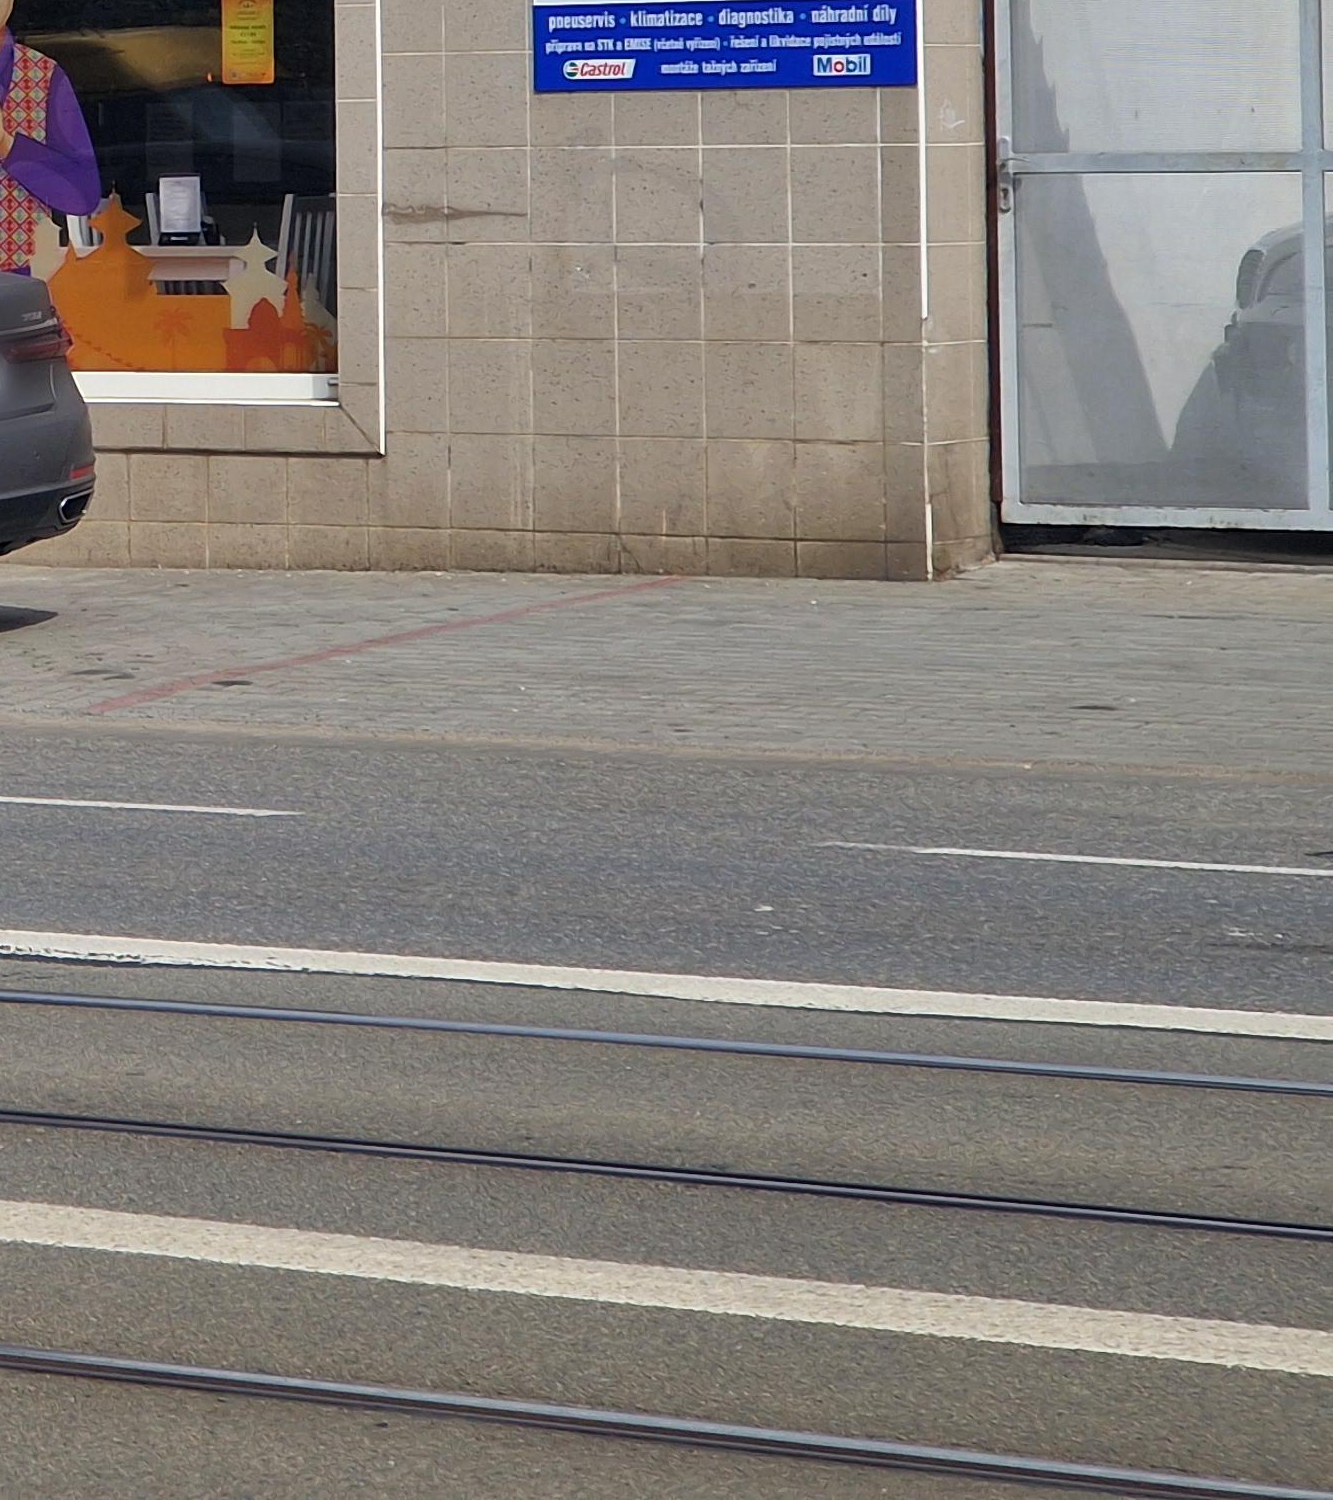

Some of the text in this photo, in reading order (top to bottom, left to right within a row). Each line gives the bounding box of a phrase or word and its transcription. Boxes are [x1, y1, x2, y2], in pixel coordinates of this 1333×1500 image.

[548, 4, 897, 33] pneuservis klimatizace diagnostika náhradní díly
[580, 62, 626, 77] Castrol
[817, 56, 867, 74] Mobil
